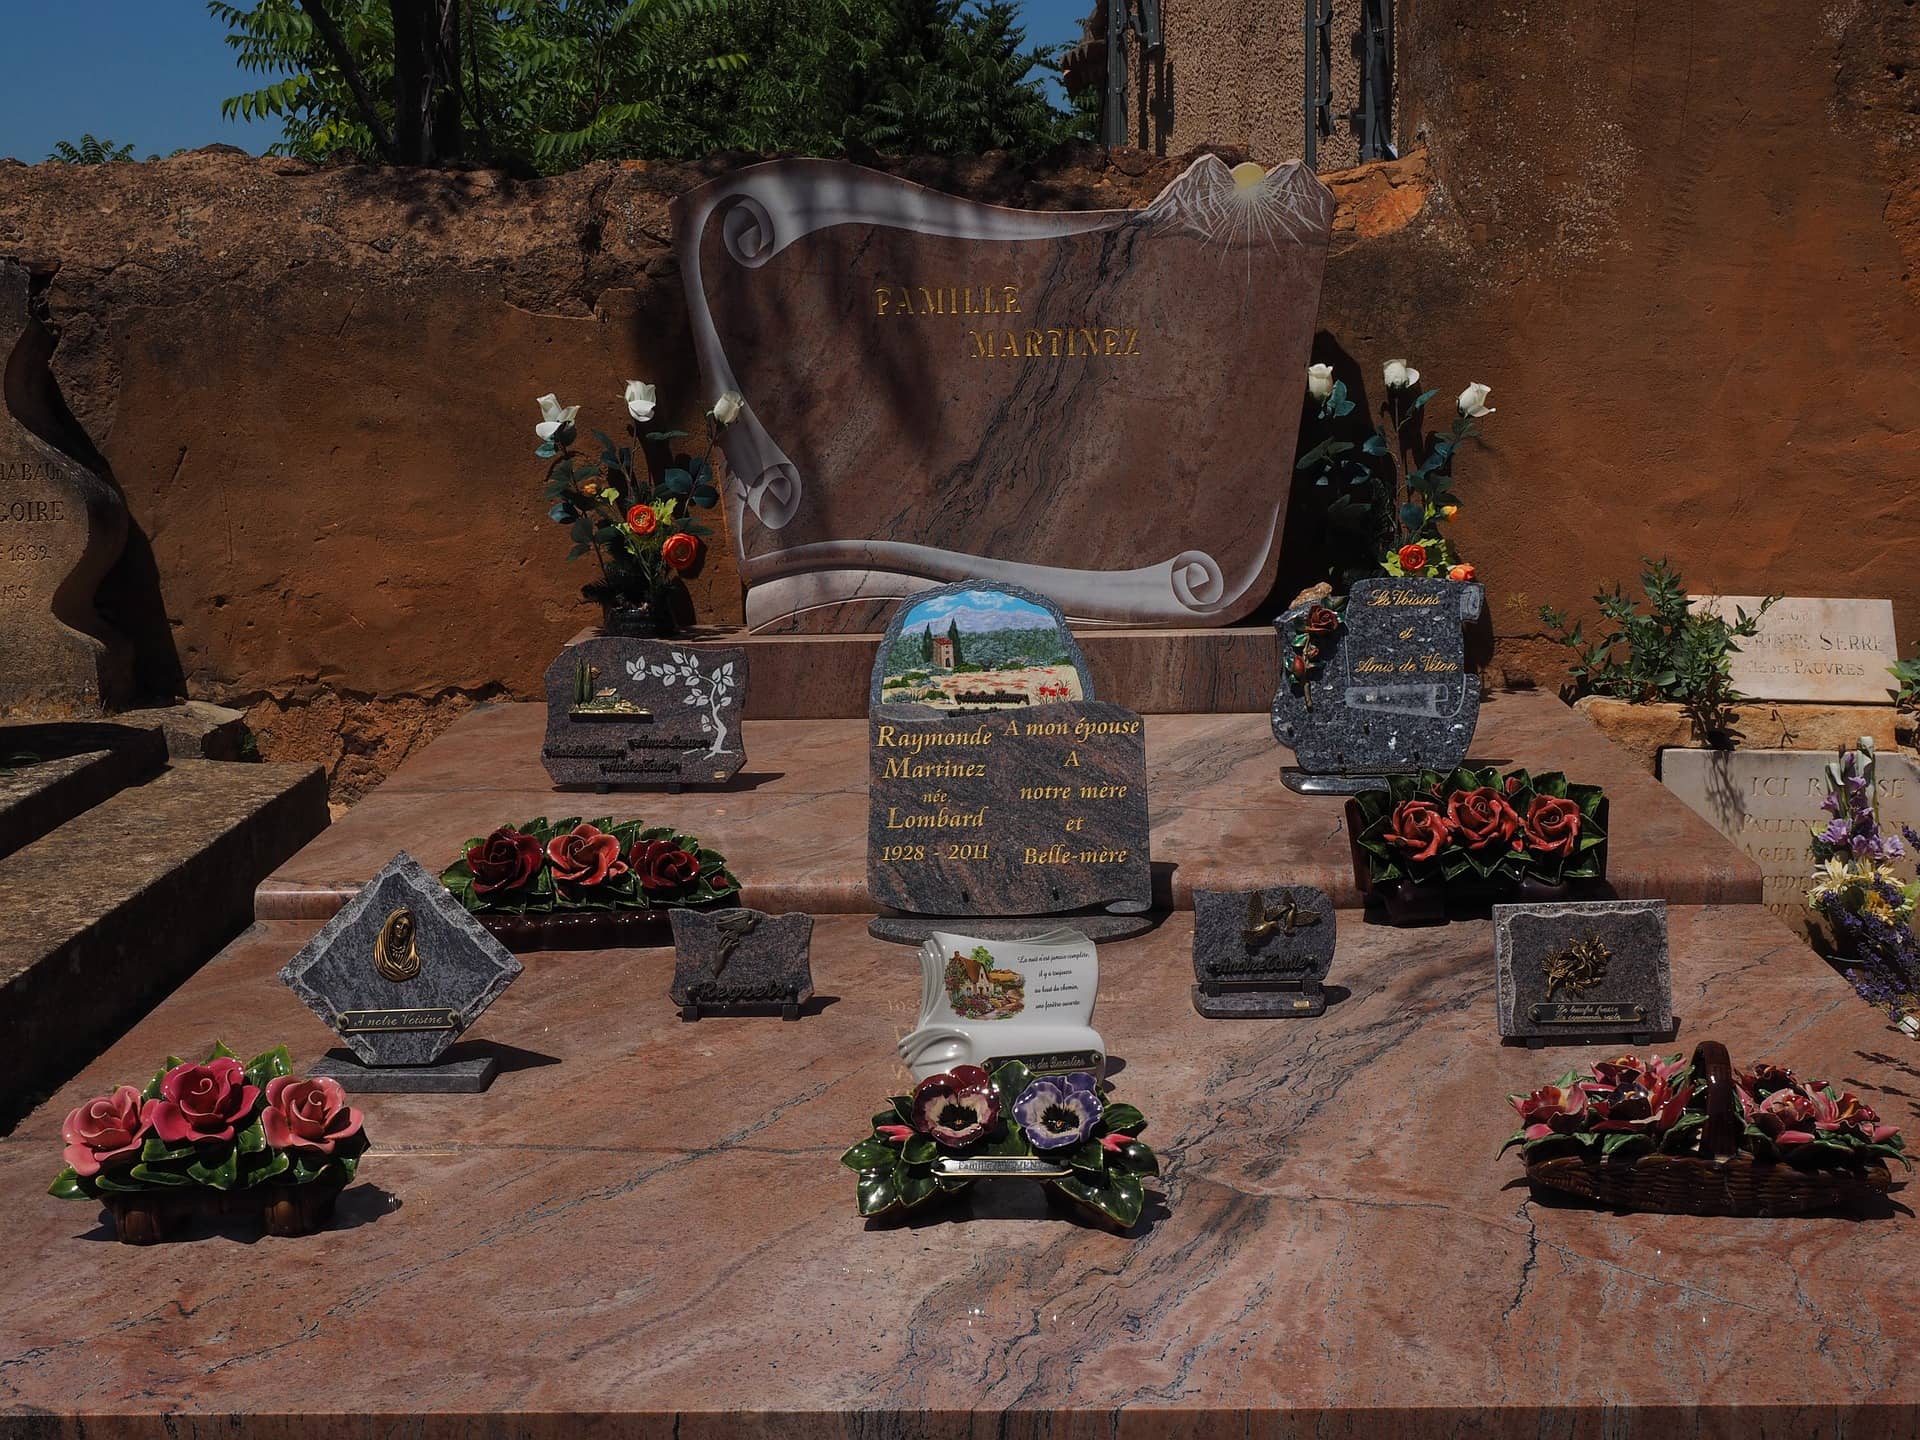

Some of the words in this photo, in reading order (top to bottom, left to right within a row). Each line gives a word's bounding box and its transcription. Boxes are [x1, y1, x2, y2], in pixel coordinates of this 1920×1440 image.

[875, 287, 1022, 315] FAMILLE
[969, 329, 1141, 358] MARTINEZ
[1392, 588, 1441, 606] Voisins
[1399, 627, 1415, 640] et
[1354, 656, 1394, 673] Amis
[1399, 657, 1417, 672] de
[1793, 658, 1865, 676] PAUVRES
[876, 724, 993, 755] Raymonde
[1003, 720, 1019, 736] A
[1026, 722, 1069, 736] mon
[1074, 717, 1140, 743] épouse
[882, 757, 986, 779] Martinez
[1064, 750, 1080, 767] A
[922, 788, 948, 803] née
[1020, 785, 1071, 800] notre
[1080, 781, 1128, 799] mère
[1751, 777, 1792, 797] ICI
[1807, 777, 1905, 798] RSE
[887, 806, 990, 830] Lombard
[1065, 816, 1084, 831] et
[882, 845, 925, 861] 1928
[950, 844, 990, 860] 2011
[1023, 844, 1128, 865] Belle-mère
[698, 980, 787, 1002] Regrets
[367, 1015, 398, 1027] notre
[401, 1012, 444, 1026] Voisine
